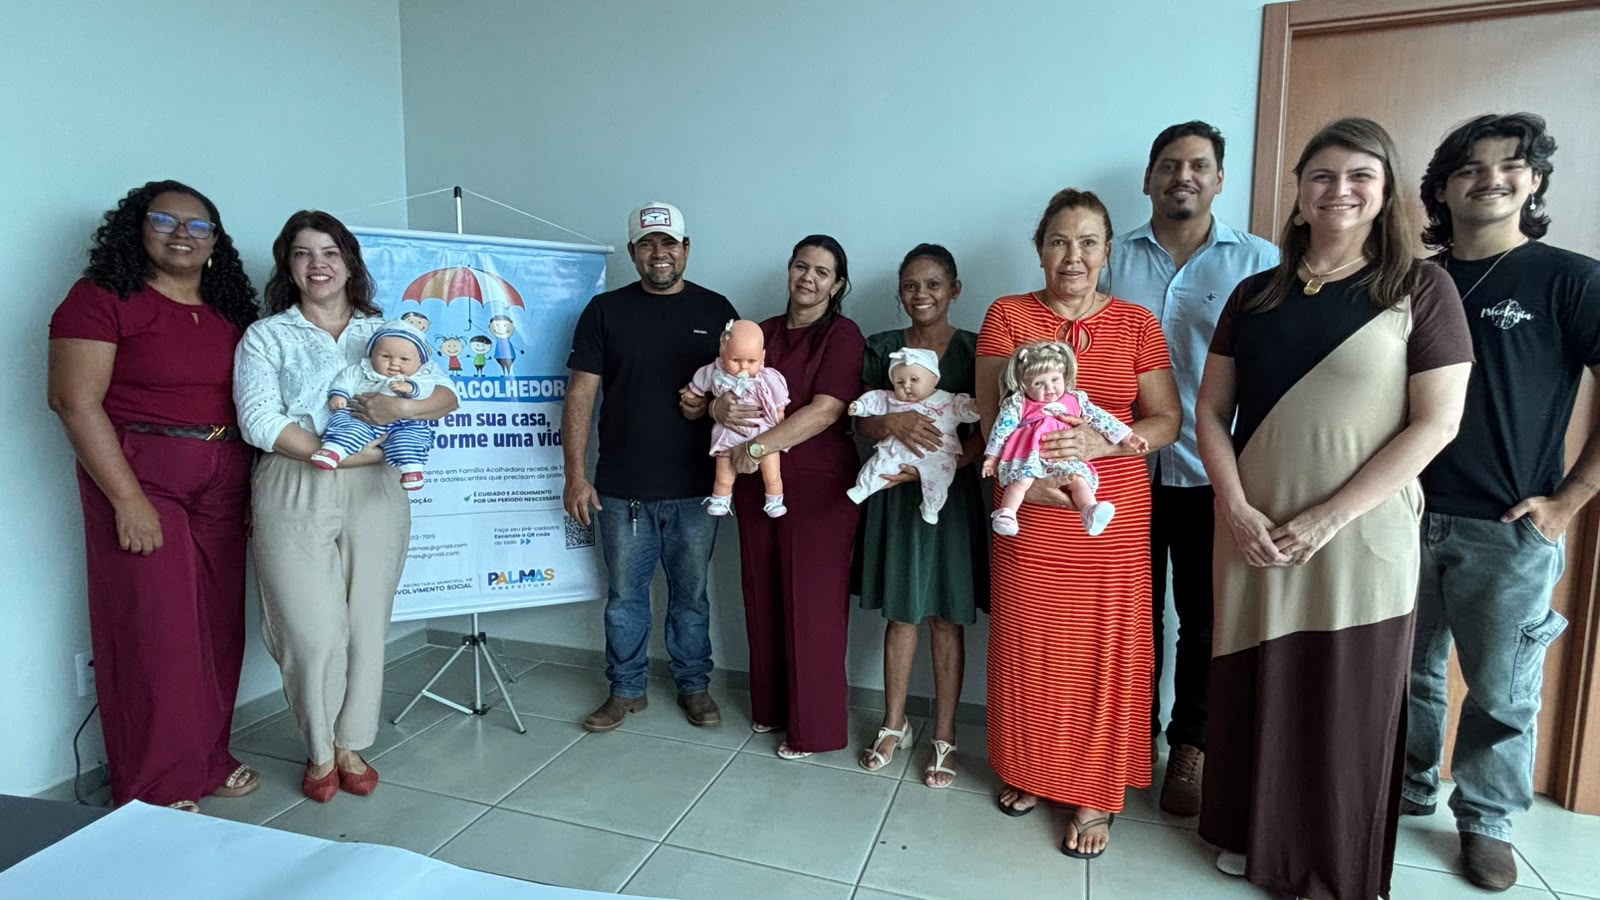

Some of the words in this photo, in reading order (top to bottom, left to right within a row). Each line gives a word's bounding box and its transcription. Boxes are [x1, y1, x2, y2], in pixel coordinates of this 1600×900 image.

[456, 379, 566, 399] ACOLHEDOR
[444, 413, 471, 427] em
[476, 412, 507, 427] sua
[511, 412, 551, 428] casa,
[493, 432, 534, 448] uma
[440, 475, 487, 483] adolescentes
[503, 474, 536, 482] precisam
[488, 568, 556, 586] PALMAS
[446, 582, 473, 590] SOCIAL
